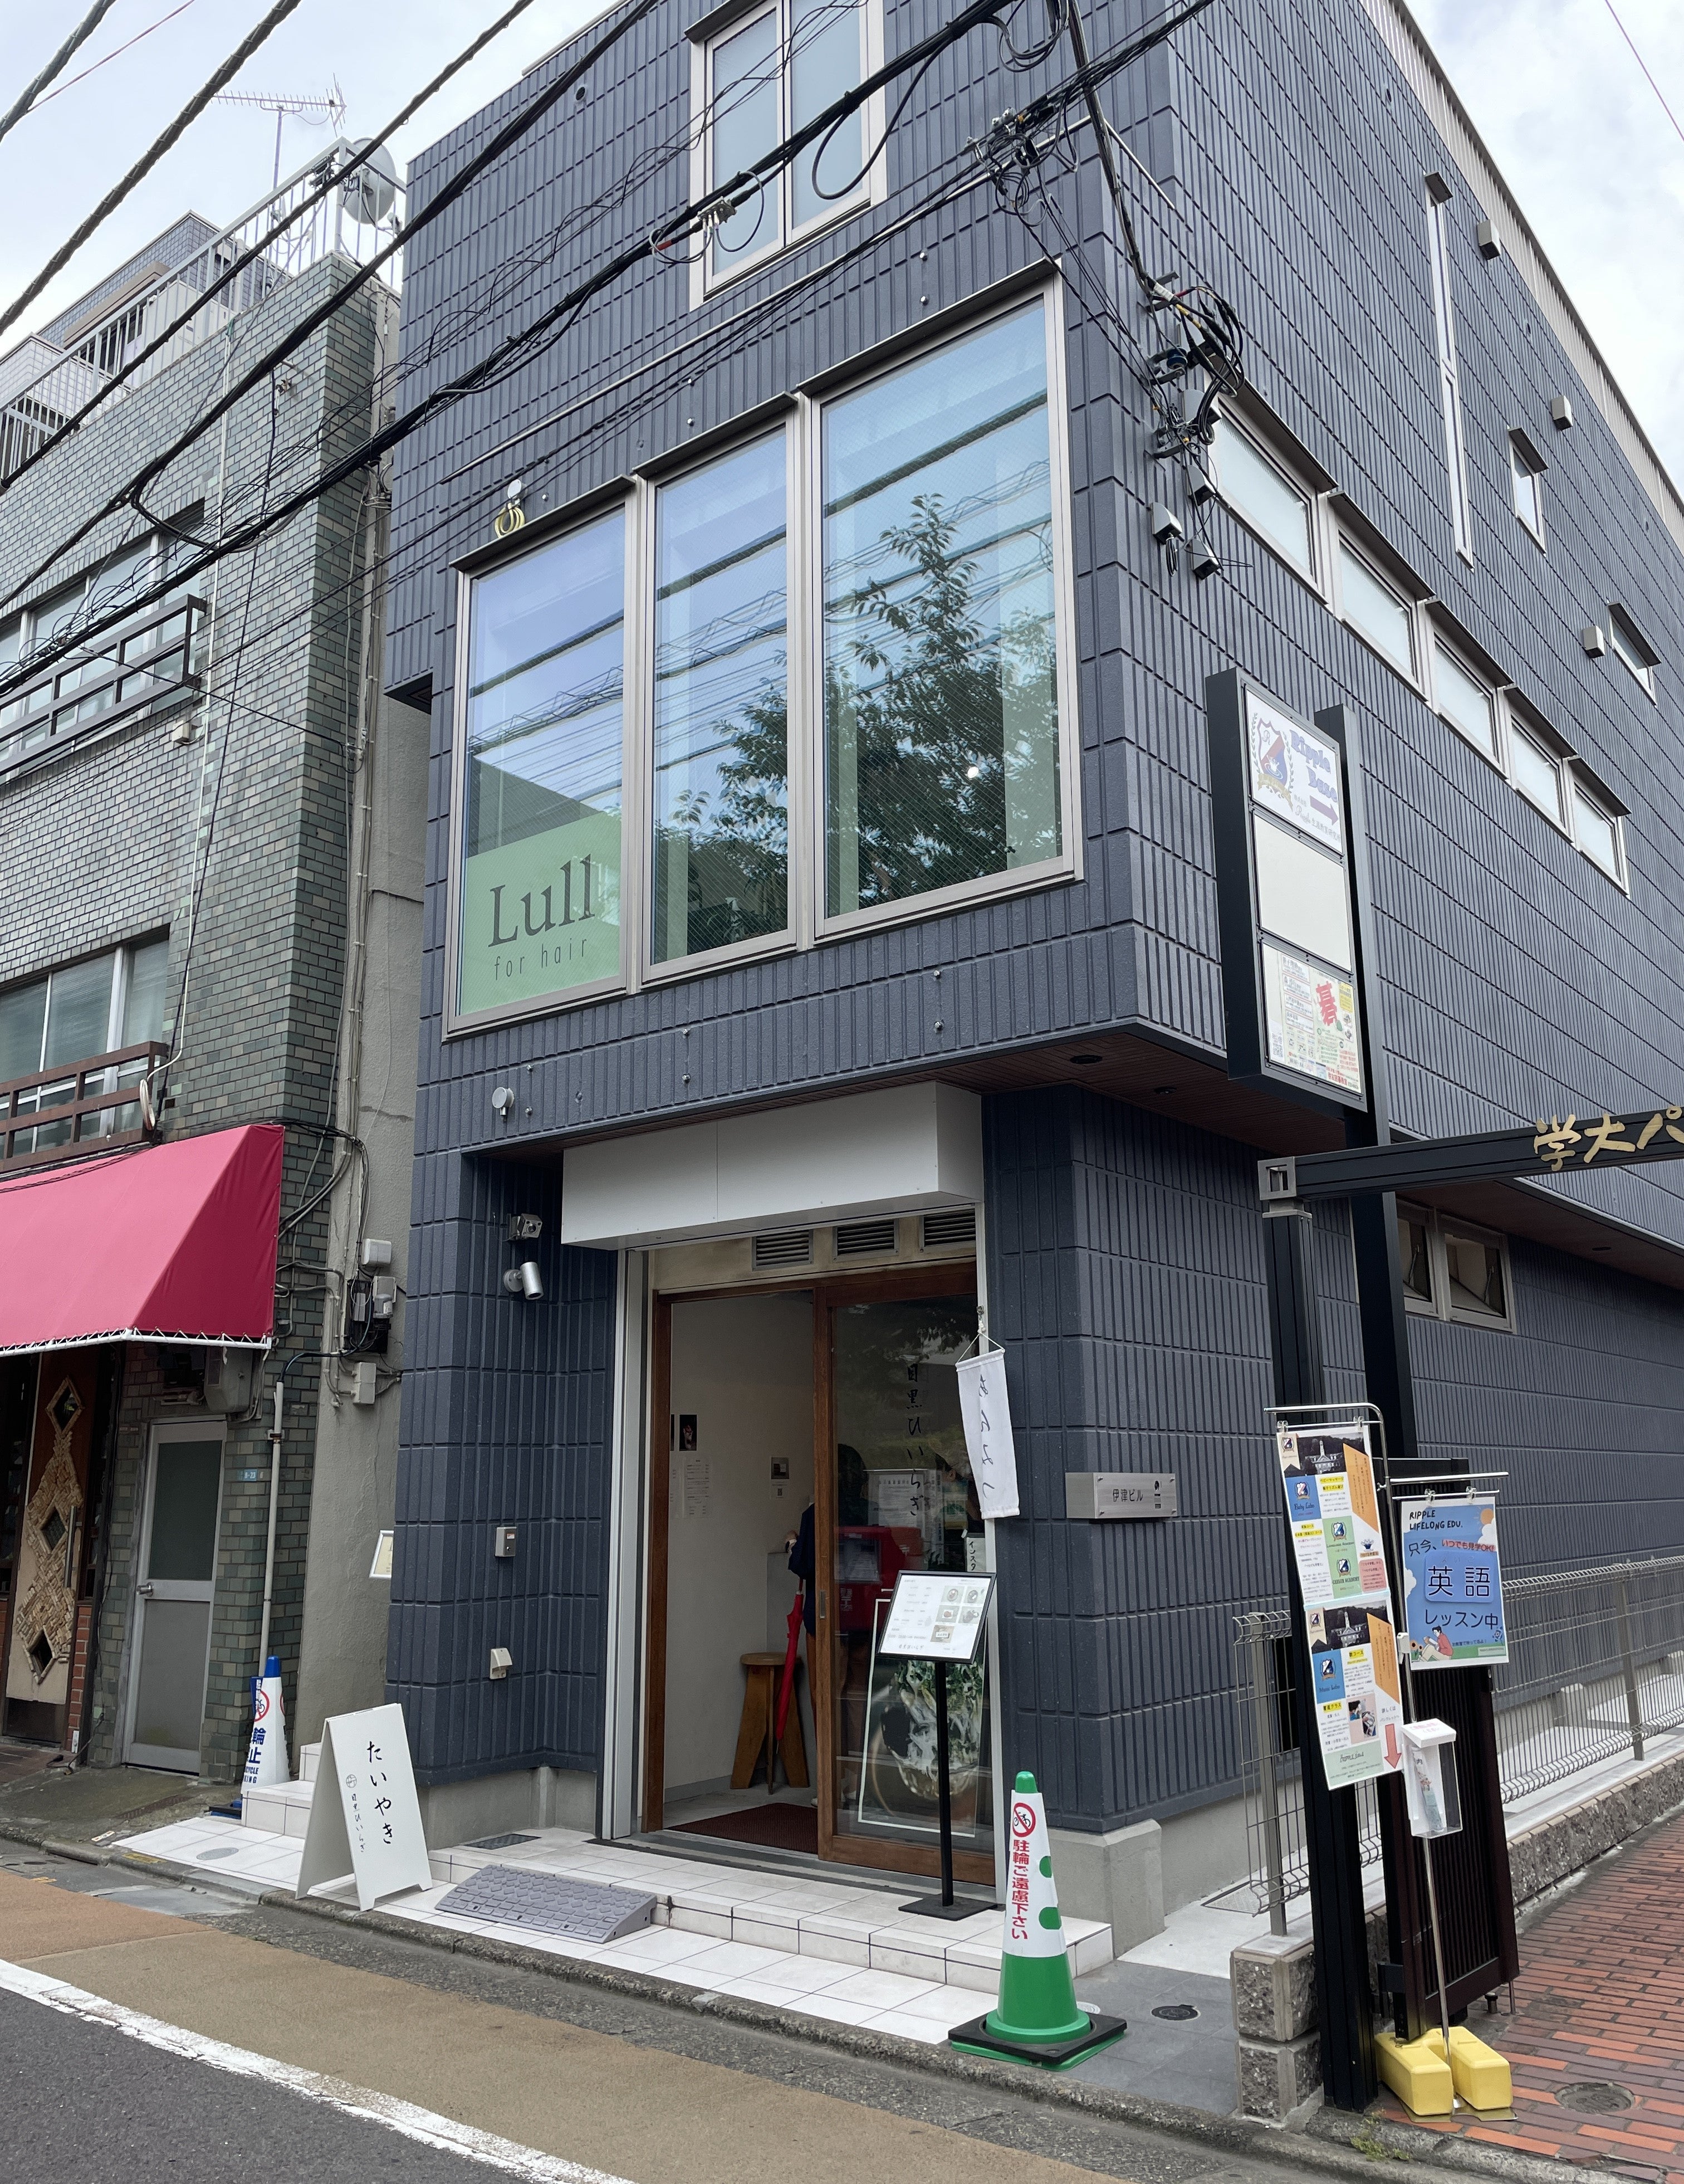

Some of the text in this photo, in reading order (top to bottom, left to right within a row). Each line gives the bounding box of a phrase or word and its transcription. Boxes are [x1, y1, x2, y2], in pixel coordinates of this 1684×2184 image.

[1289, 729, 1331, 774] Ripple
[1306, 765, 1338, 803] Base
[488, 853, 595, 947] Lull
[494, 937, 587, 981] for hair
[1534, 1106, 1684, 1171] 学大パ
[906, 1364, 924, 1516] 目黒ひいらぎ
[1113, 1488, 1143, 1502] 伊津ビル
[1409, 1509, 1436, 1521] RIPPLE
[1409, 1521, 1445, 1531] LIFELONG
[1408, 1539, 1436, 1557] 只今、
[1428, 1565, 1490, 1596] 英語
[1425, 1609, 1498, 1630] レッスン中
[366, 1741, 393, 1845] たいやき
[1011, 1839, 1030, 1940] 駐輪ご遠慮下さい
